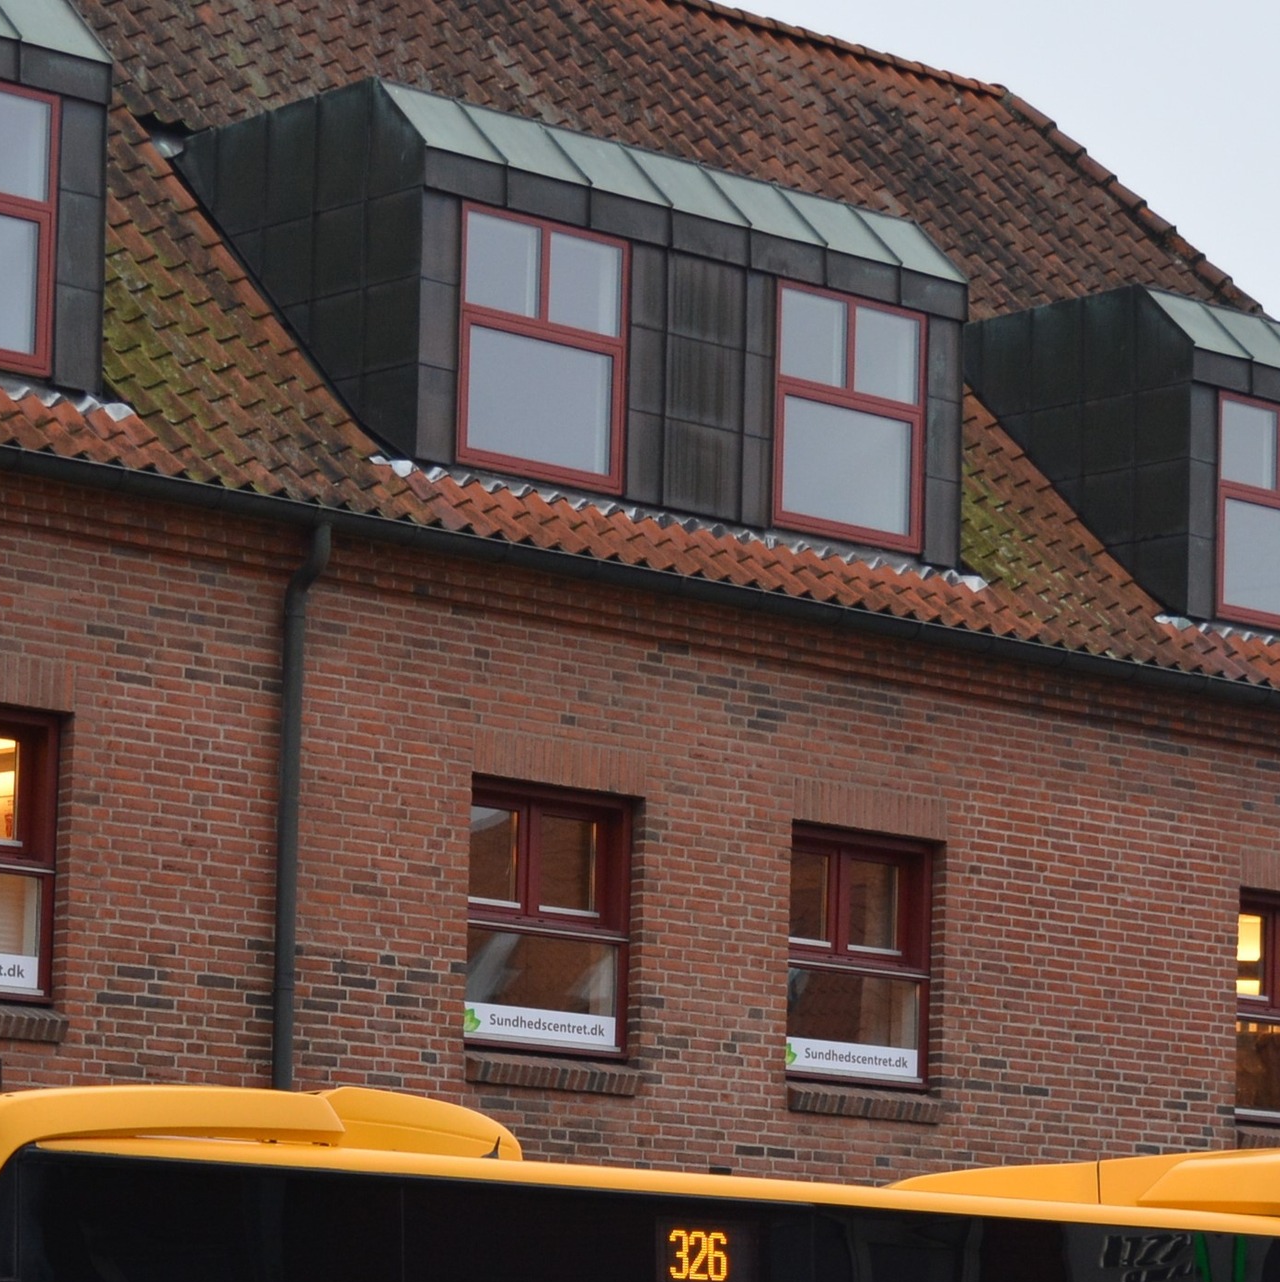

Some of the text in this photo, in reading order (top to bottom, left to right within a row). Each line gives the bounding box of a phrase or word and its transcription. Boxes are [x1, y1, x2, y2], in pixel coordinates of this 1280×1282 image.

[489, 1013, 606, 1037] Sundhedscentret.dk
[804, 1047, 908, 1069] Sundhedscentret.dk
[669, 1229, 728, 1281] 326
